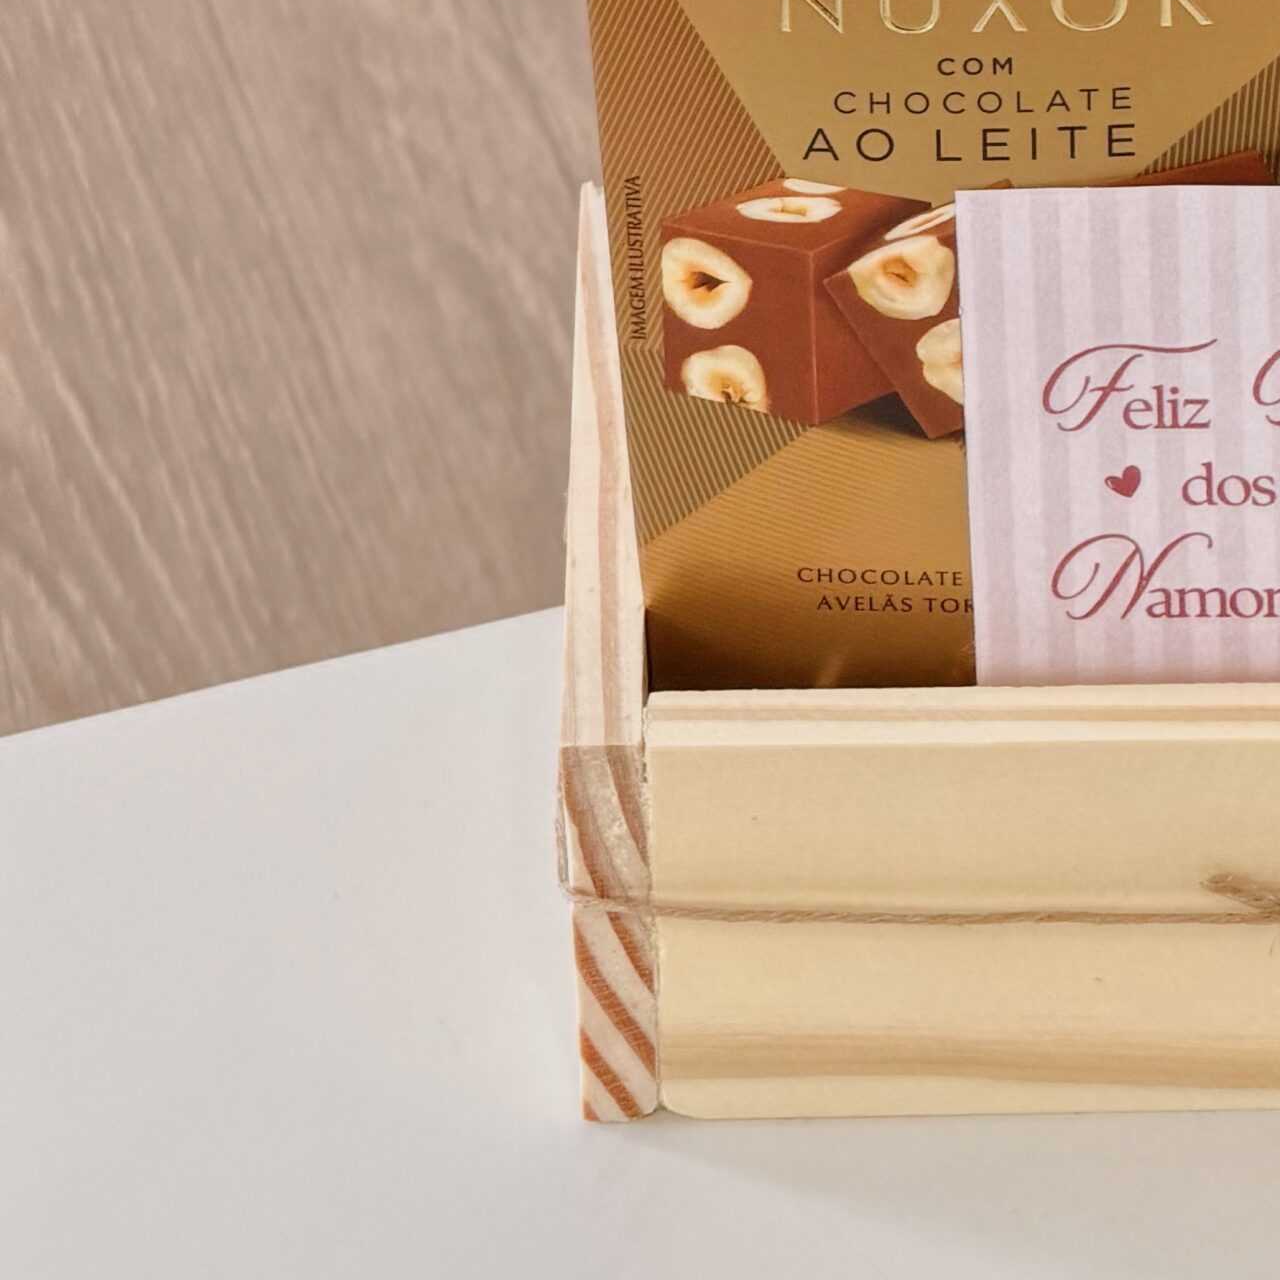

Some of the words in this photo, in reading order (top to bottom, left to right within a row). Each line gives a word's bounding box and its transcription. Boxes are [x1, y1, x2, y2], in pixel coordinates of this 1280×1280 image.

[937, 56, 1013, 76] COM
[833, 86, 1133, 114] CHOCOLATE
[802, 127, 895, 162] AO
[935, 123, 1136, 162] LEITE
[624, 175, 645, 272] ILUSTRATIVA
[628, 277, 647, 340] IMAGEM
[1041, 337, 1218, 432] Feliz
[1181, 461, 1277, 507] dos
[797, 567, 963, 587] CHOCOLATE
[816, 593, 913, 613] AVELÃS
